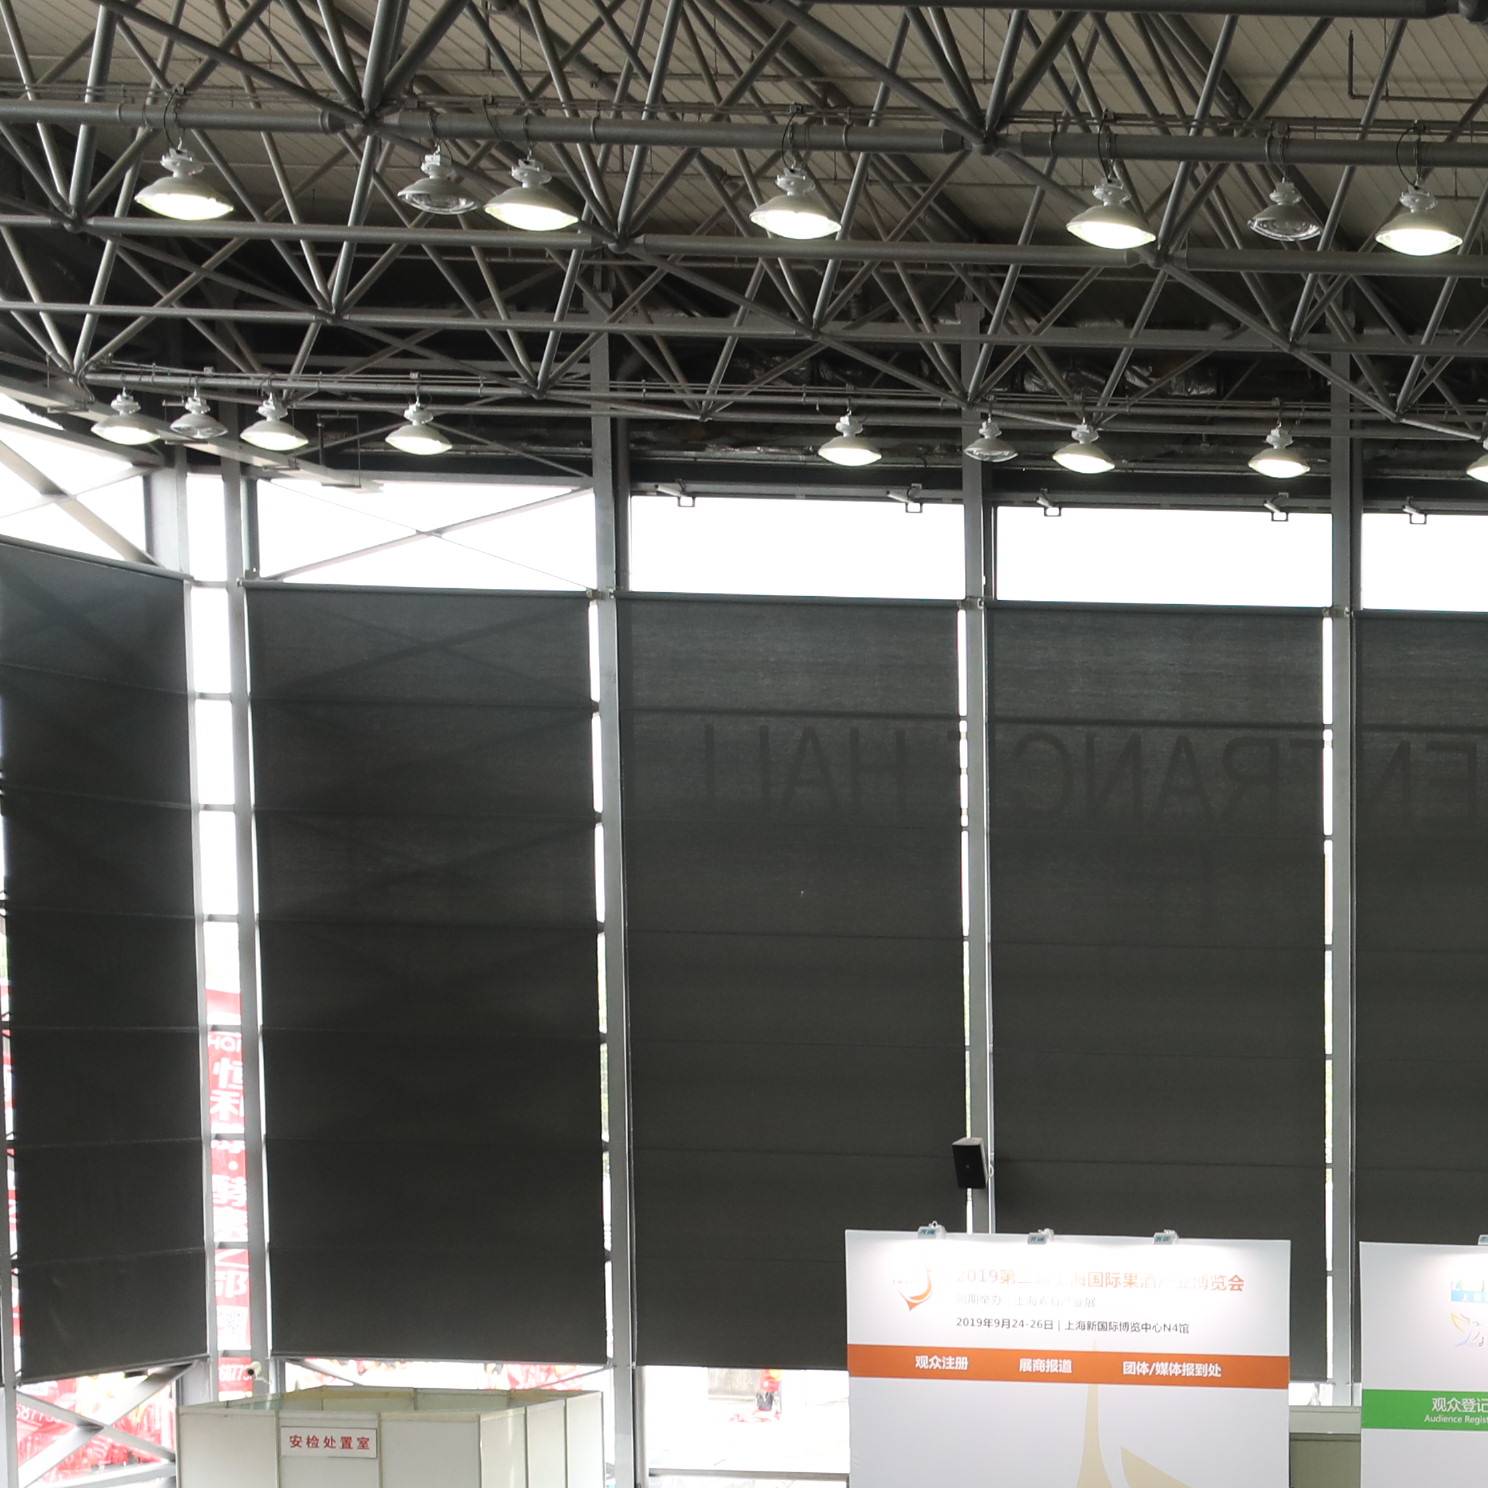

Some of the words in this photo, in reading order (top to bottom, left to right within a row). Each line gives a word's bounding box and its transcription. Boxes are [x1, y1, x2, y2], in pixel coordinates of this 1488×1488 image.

[955, 1316, 1055, 1332] 2019年9月24-26日
[1064, 1319, 1190, 1335] 上海新国际博览中心N4馆
[915, 1355, 969, 1371] 观众注册
[1019, 1358, 1073, 1374] 展商报道
[1123, 1361, 1222, 1378] 团体/媒体报到处
[1424, 1413, 1463, 1424] Audience
[288, 1433, 371, 1451] 安检处置室
